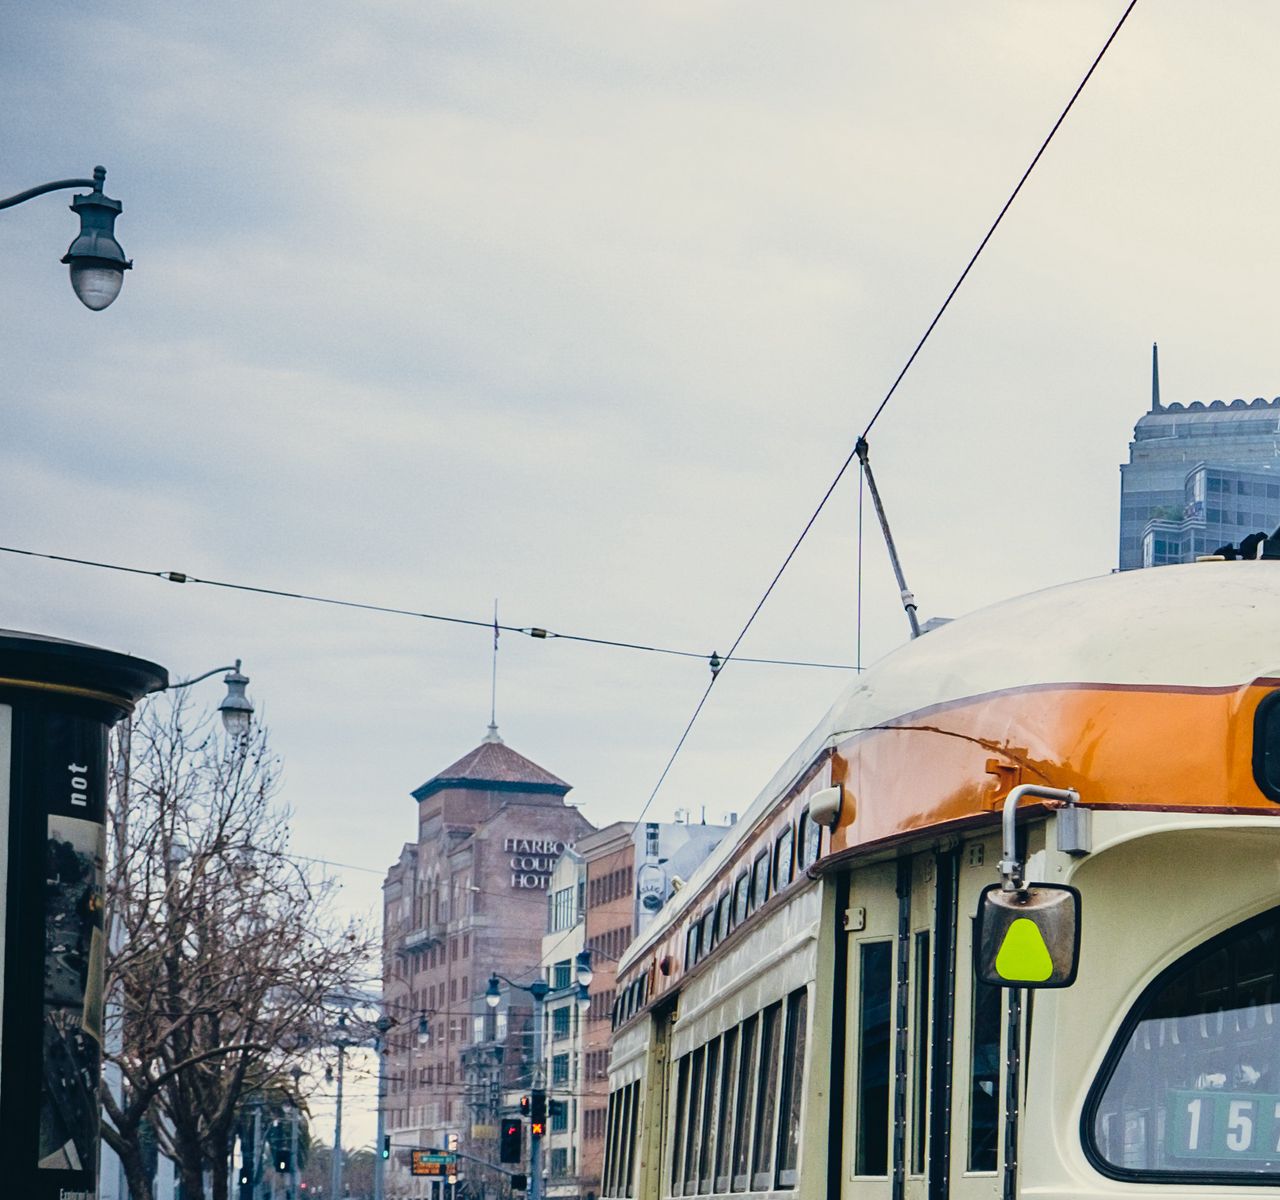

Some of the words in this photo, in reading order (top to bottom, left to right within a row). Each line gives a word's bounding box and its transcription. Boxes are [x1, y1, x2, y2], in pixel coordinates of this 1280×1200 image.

[68, 763, 88, 807] not
[504, 838, 577, 854] HARBOR
[510, 856, 557, 871] COU
